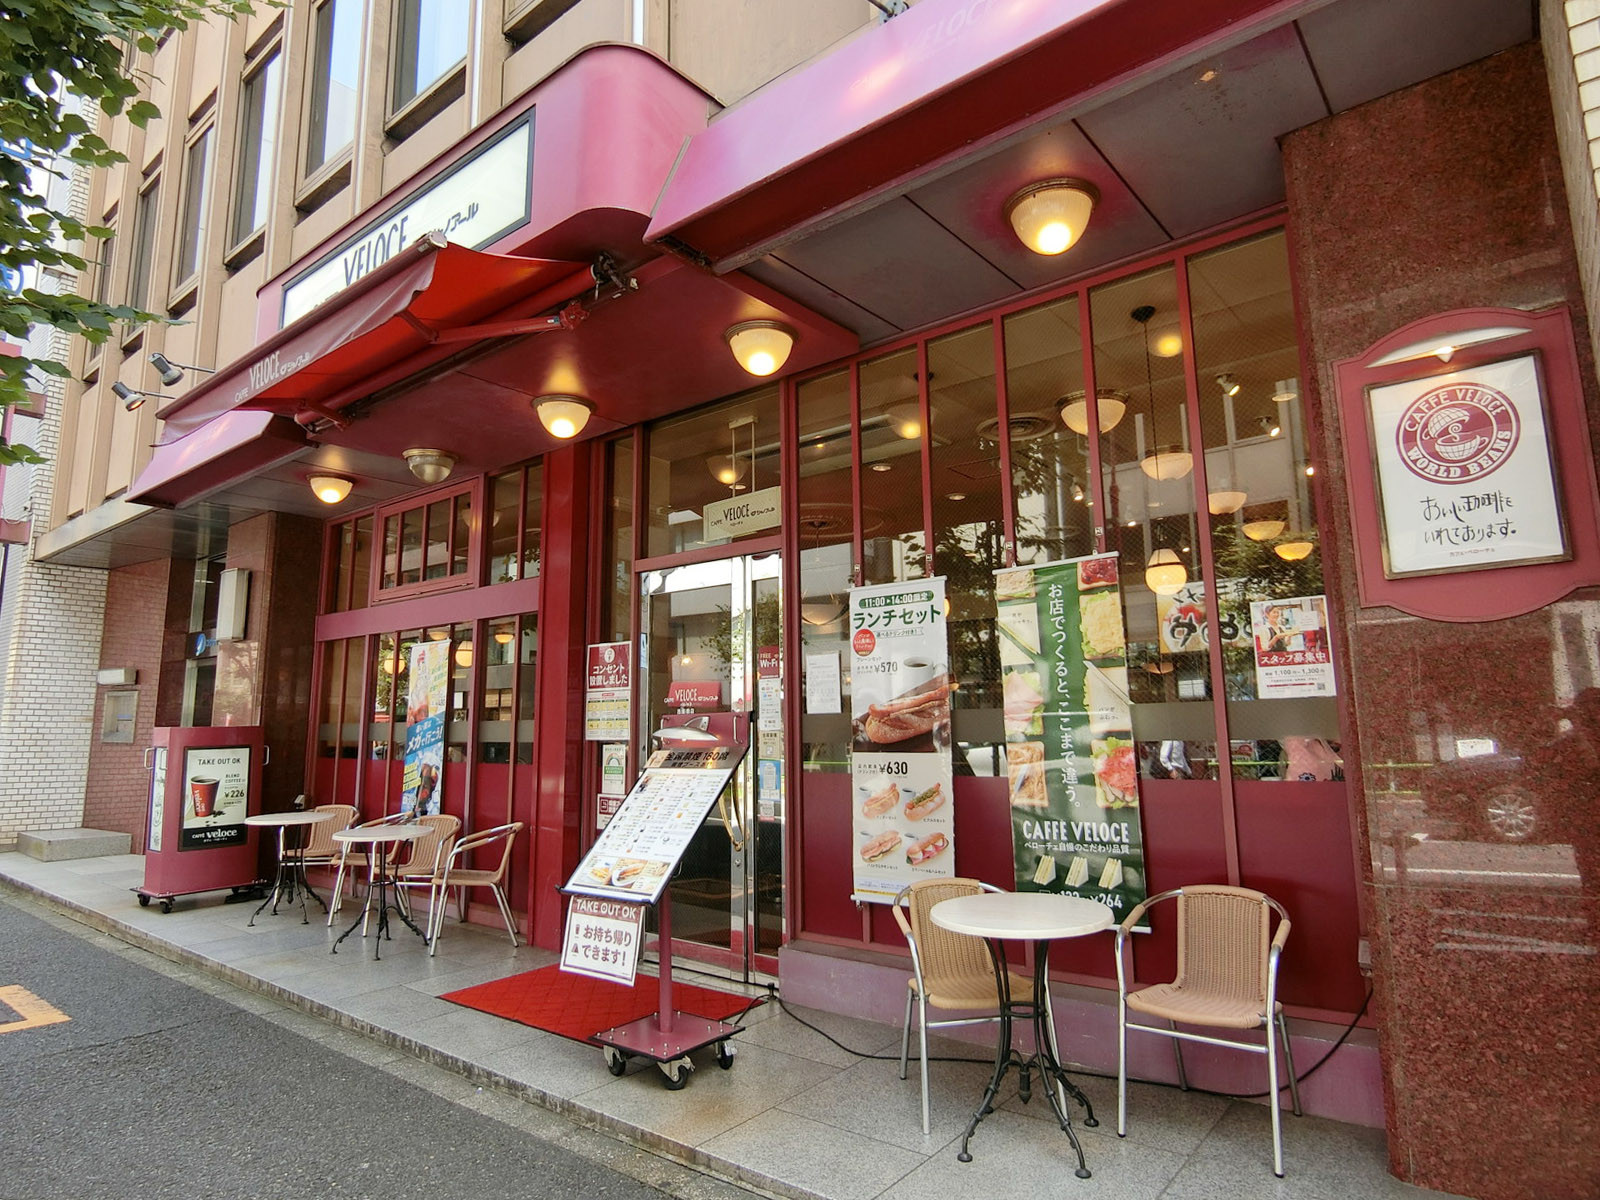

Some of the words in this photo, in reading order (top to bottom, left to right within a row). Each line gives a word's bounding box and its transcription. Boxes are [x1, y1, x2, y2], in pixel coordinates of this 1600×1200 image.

[249, 350, 280, 391] VELOCE
[1456, 388, 1506, 416] VELOCE
[1407, 446, 1461, 478] WORLD
[1467, 430, 1512, 475] BEANS
[723, 504, 750, 521] VELOCE
[1420, 490, 1514, 522] おいしい珈琲を
[1424, 518, 1517, 545] いれております。
[853, 604, 942, 630] ランチセット
[760, 658, 778, 668] Wi-Fi
[874, 661, 898, 673] ¥570
[1260, 652, 1326, 665] スタッフ募集中
[592, 663, 625, 675] コンセント
[589, 673, 628, 687] 設置しました
[675, 688, 698, 702] VELOCE
[1048, 583, 1081, 808] お店でつくると、ここまで違う。
[198, 758, 216, 766] TAKE
[217, 757, 230, 765] OUT
[879, 761, 908, 775] ¥630
[224, 789, 245, 798] ¥226
[206, 828, 238, 839] veloce
[1071, 821, 1130, 843] VELOCE
[1024, 841, 1130, 855] ベローチェ自慢のこだわり品質
[576, 899, 599, 913] TAKE
[600, 902, 621, 917] OUT
[621, 905, 637, 920] OK
[583, 924, 632, 947] お持ち帰り
[582, 944, 627, 967] できます!
